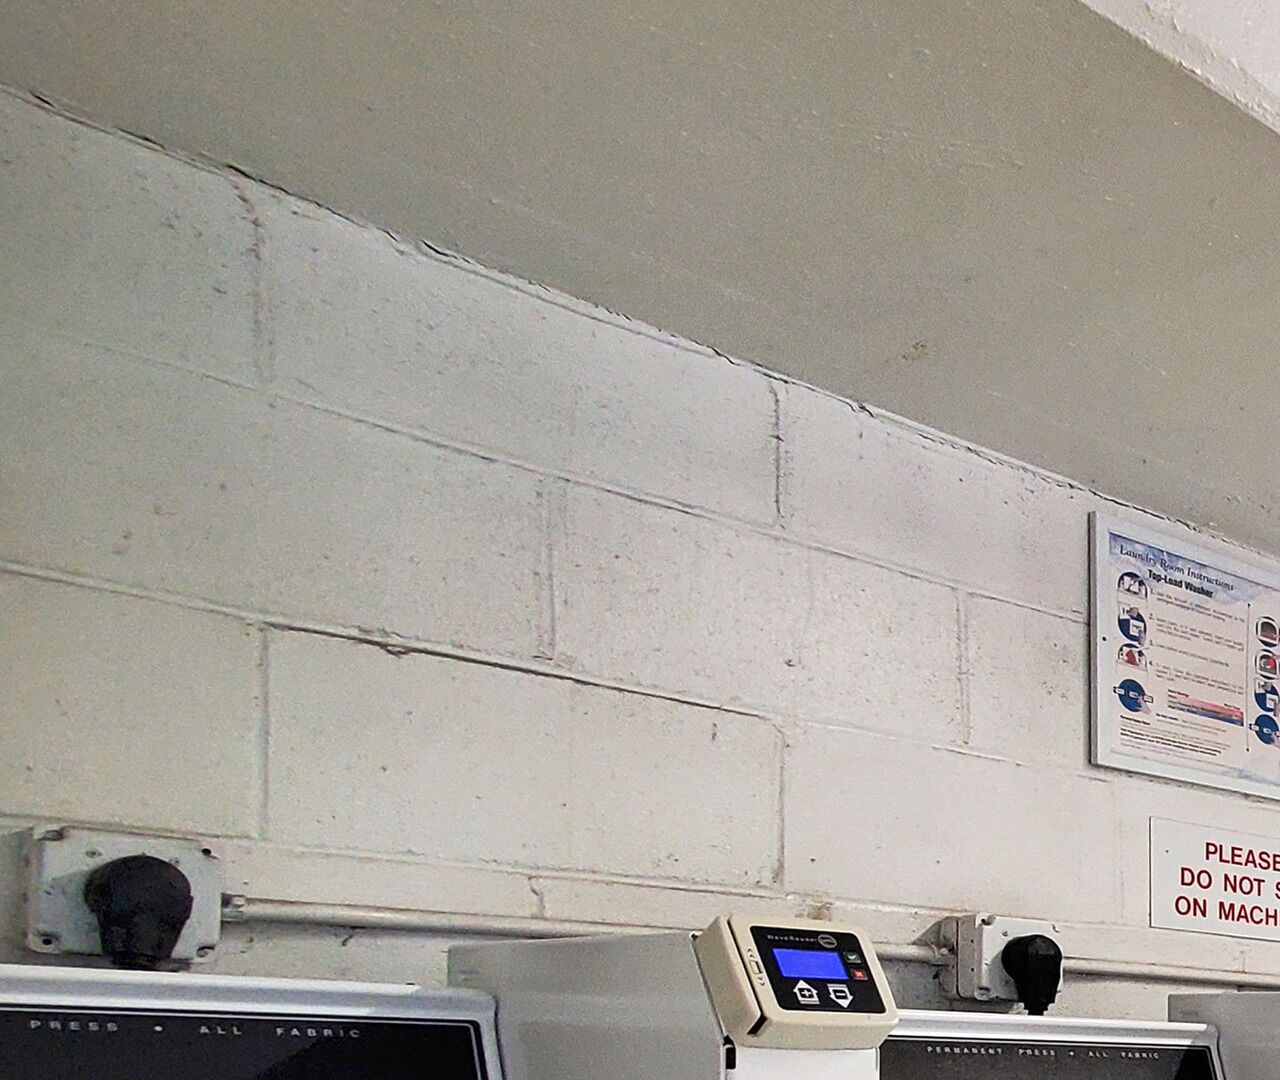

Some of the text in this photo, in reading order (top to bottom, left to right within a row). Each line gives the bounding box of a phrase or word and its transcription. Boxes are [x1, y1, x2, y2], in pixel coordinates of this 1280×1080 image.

[1120, 544, 1158, 568] Laundry
[1187, 567, 1234, 591] Instructions
[1147, 568, 1214, 598] Top-Load Washer
[1180, 867, 1213, 889] DO
[1223, 874, 1266, 896] NOT
[1175, 896, 1207, 918] ON
[30, 1019, 361, 1038] PRESS ALL FABRIC
[927, 1046, 1003, 1055] PERMANENT
